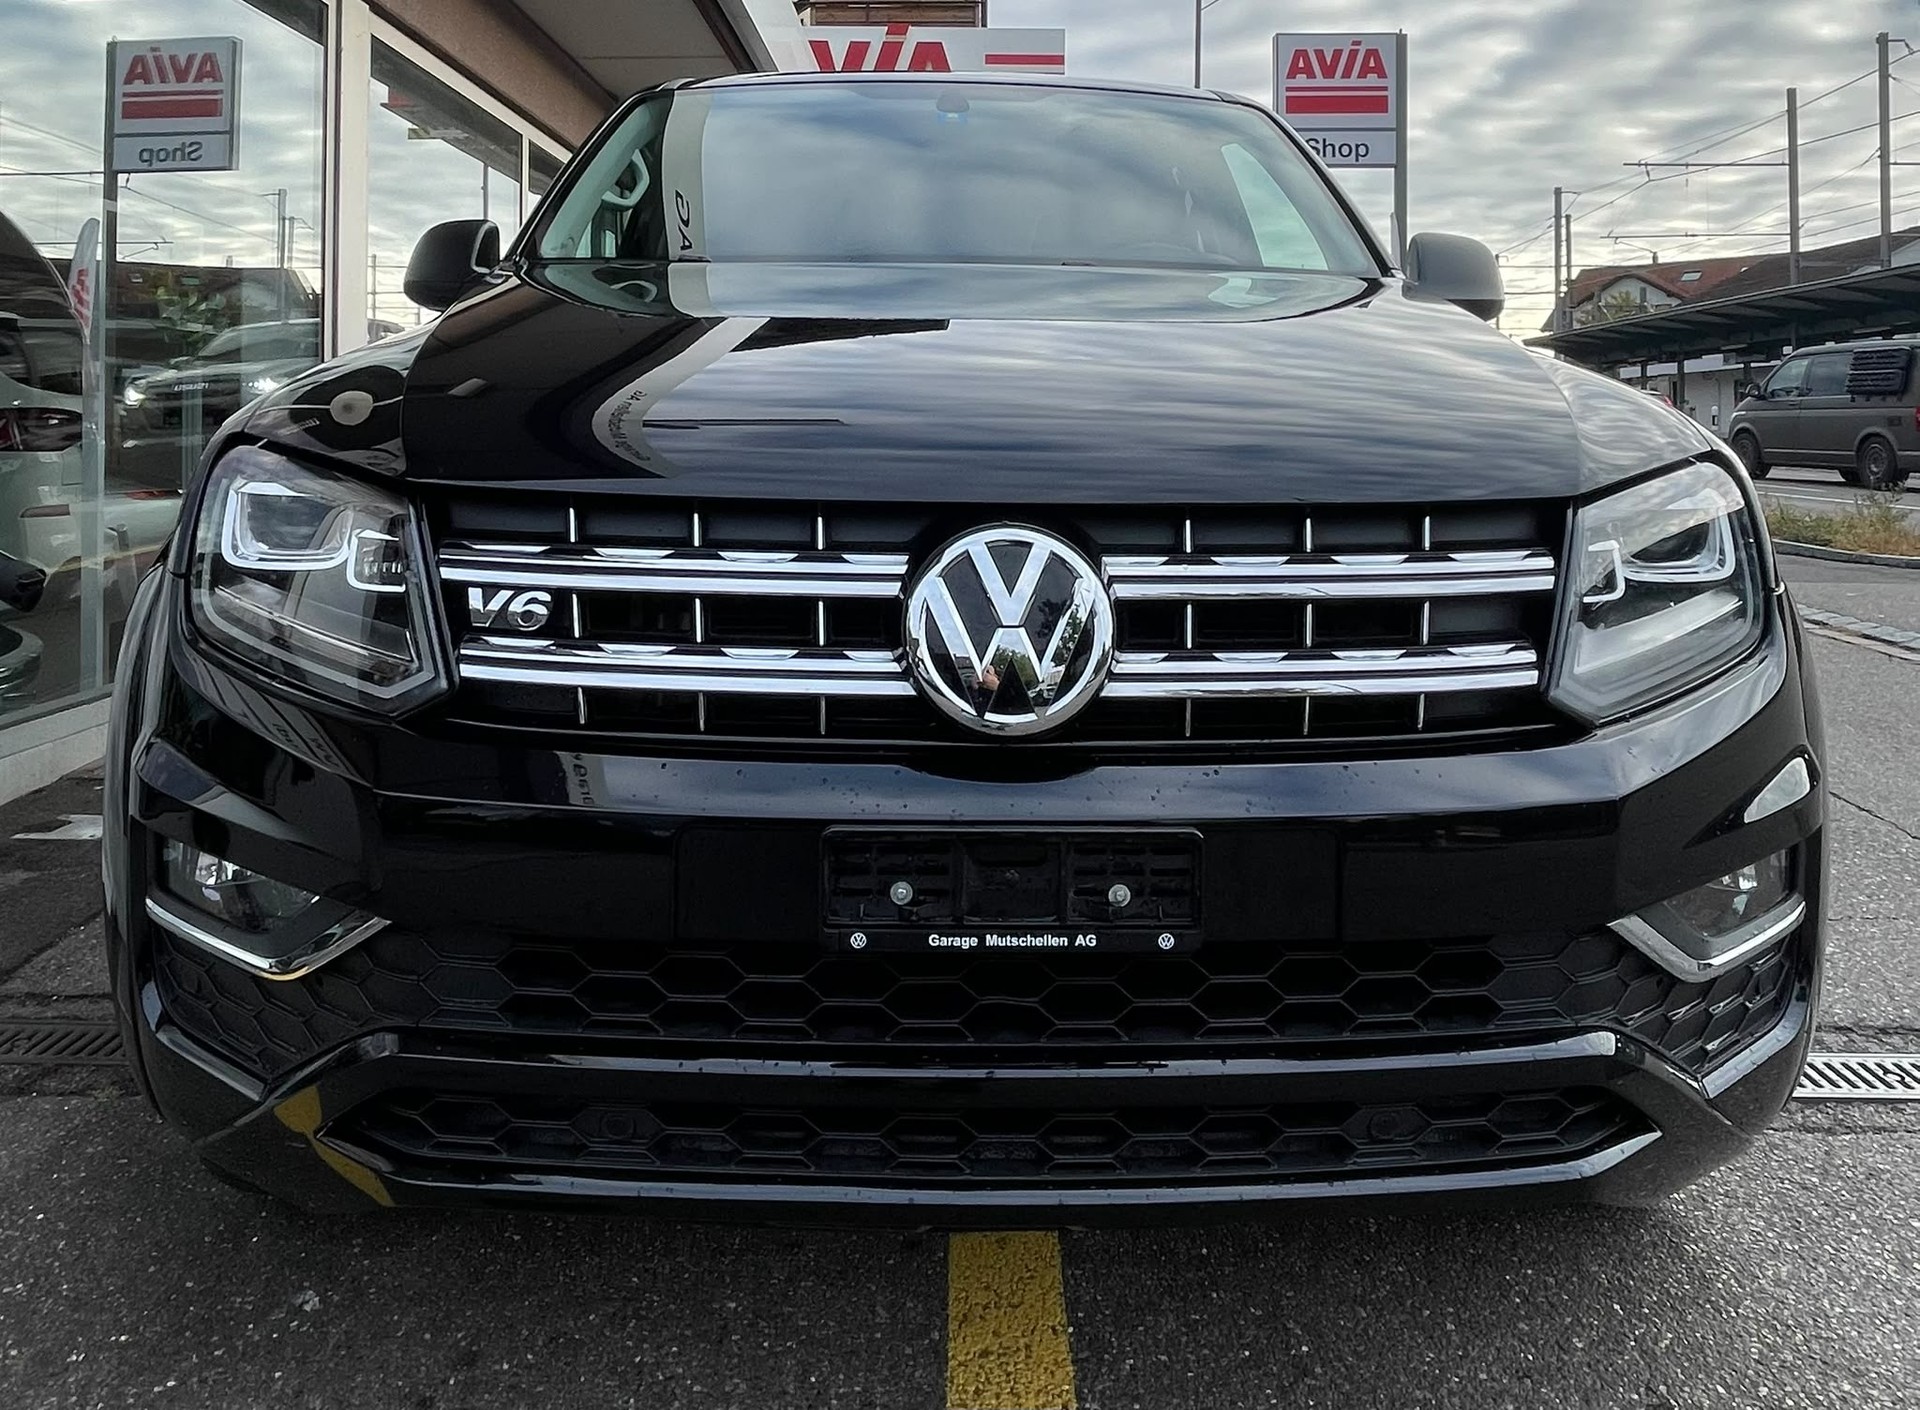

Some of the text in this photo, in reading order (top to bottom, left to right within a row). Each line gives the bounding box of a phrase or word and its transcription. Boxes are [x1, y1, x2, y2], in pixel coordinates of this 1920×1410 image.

[808, 23, 952, 72] VIA
[1285, 40, 1388, 79] AVIA
[467, 587, 552, 632] V6
[928, 934, 1098, 949] Garage Mutschellen AG
